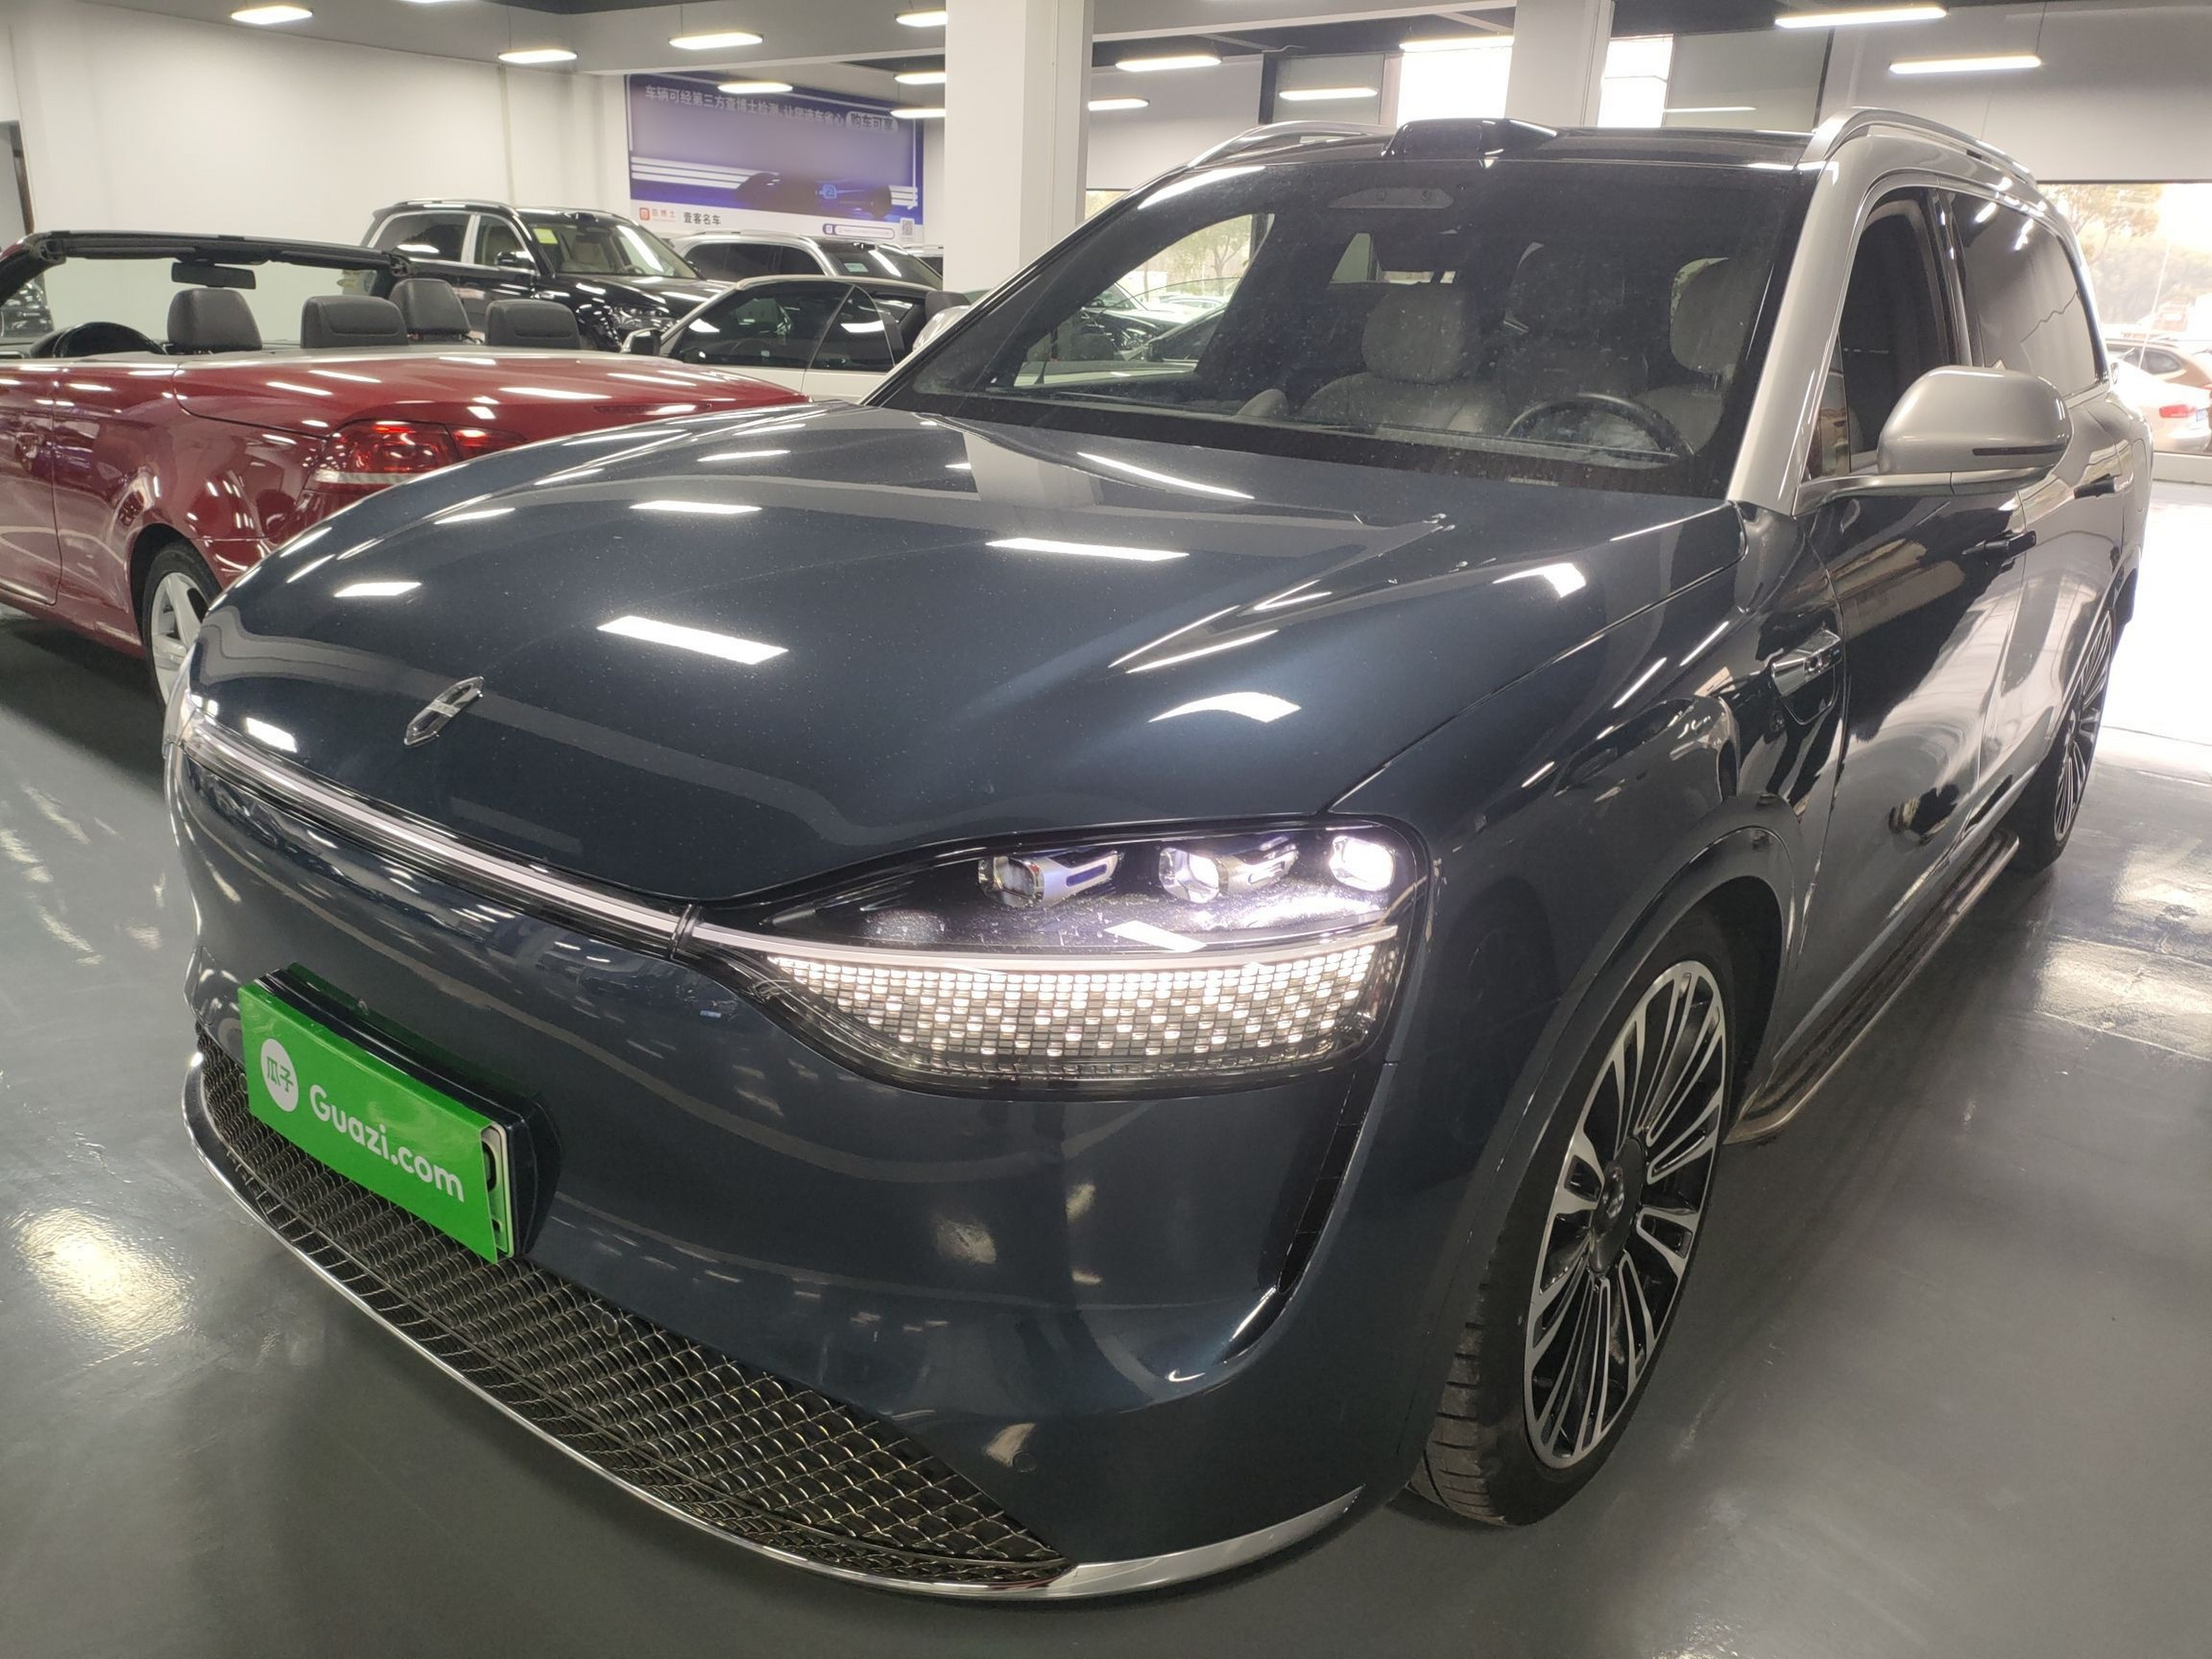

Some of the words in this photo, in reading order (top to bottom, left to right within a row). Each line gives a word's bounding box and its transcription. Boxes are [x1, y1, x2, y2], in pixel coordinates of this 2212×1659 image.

[684, 211, 721, 225] 壹客名车
[266, 1056, 294, 1093] 瓜子
[309, 1084, 465, 1203] Guazi.com
